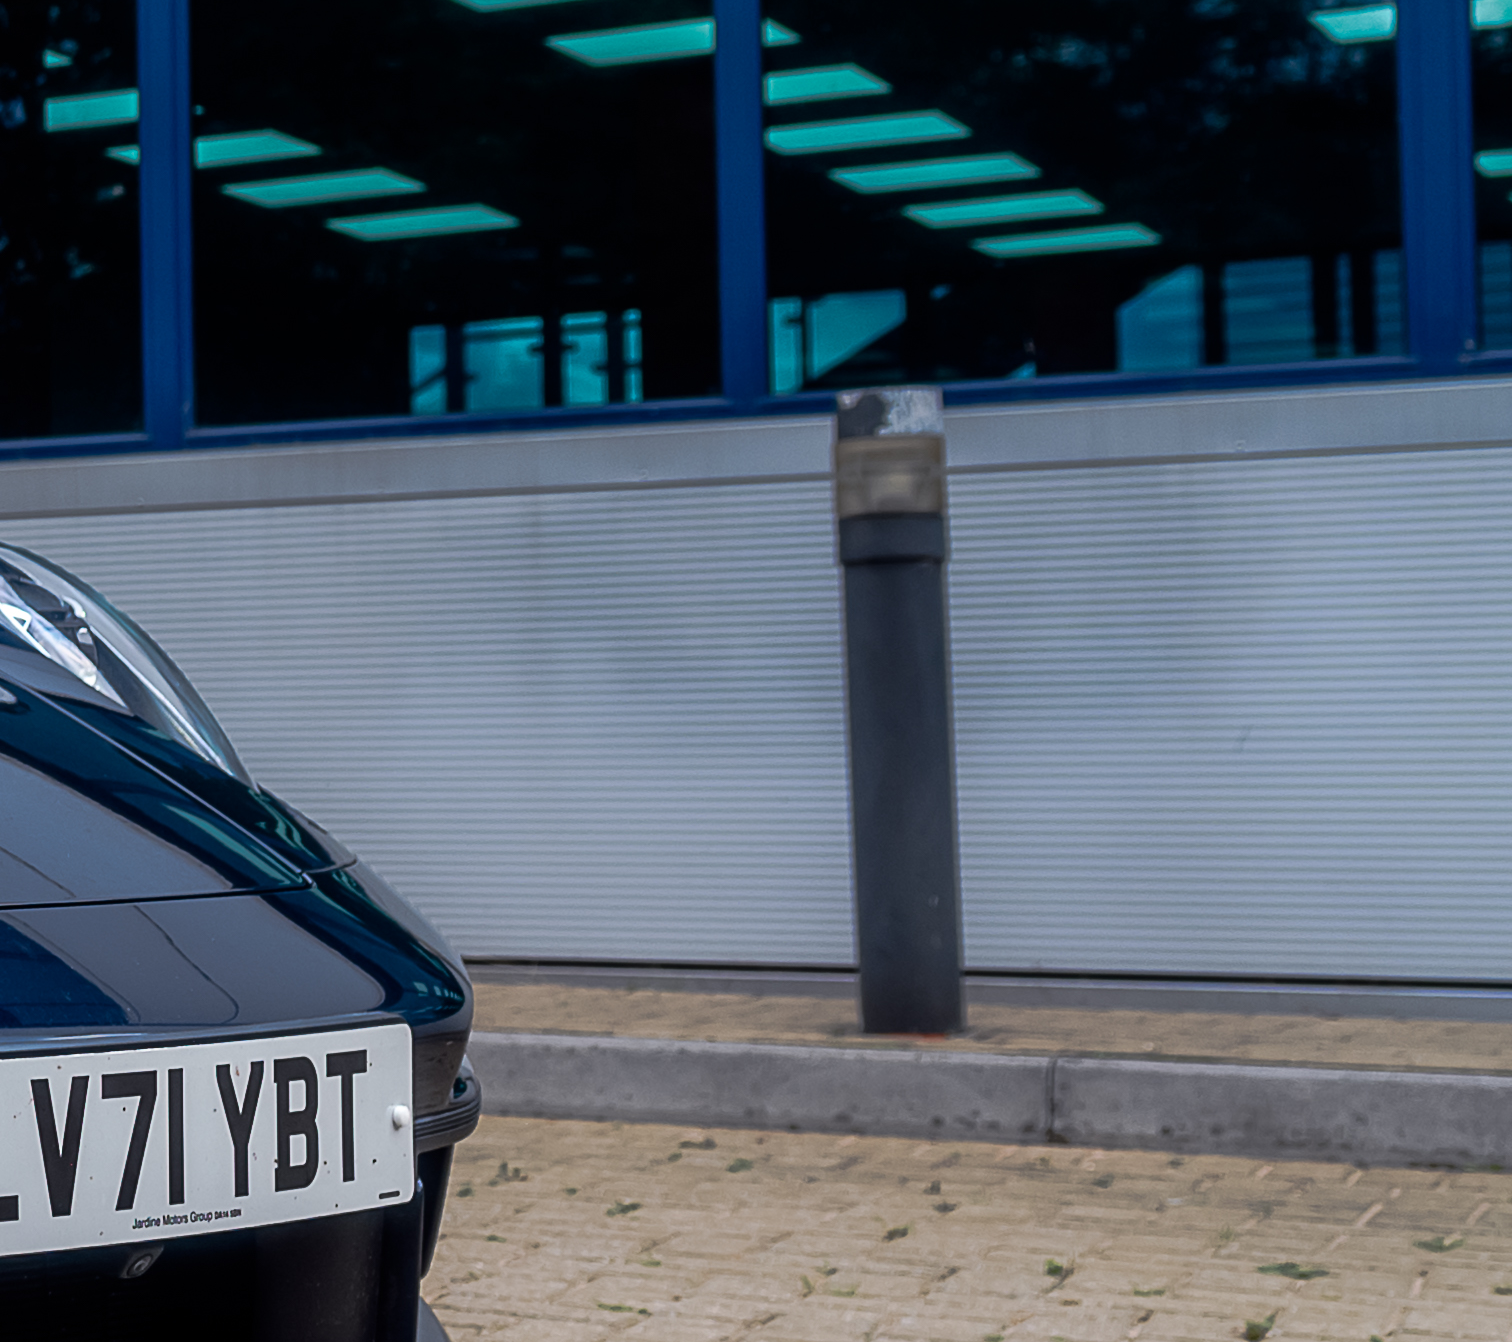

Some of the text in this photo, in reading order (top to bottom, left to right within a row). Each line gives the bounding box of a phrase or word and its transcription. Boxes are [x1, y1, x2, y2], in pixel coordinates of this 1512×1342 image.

[215, 1048, 368, 1198] YBT
[132, 1215, 161, 1230] Jardine
[162, 1213, 188, 1226] Motors
[189, 1210, 213, 1225] Group
